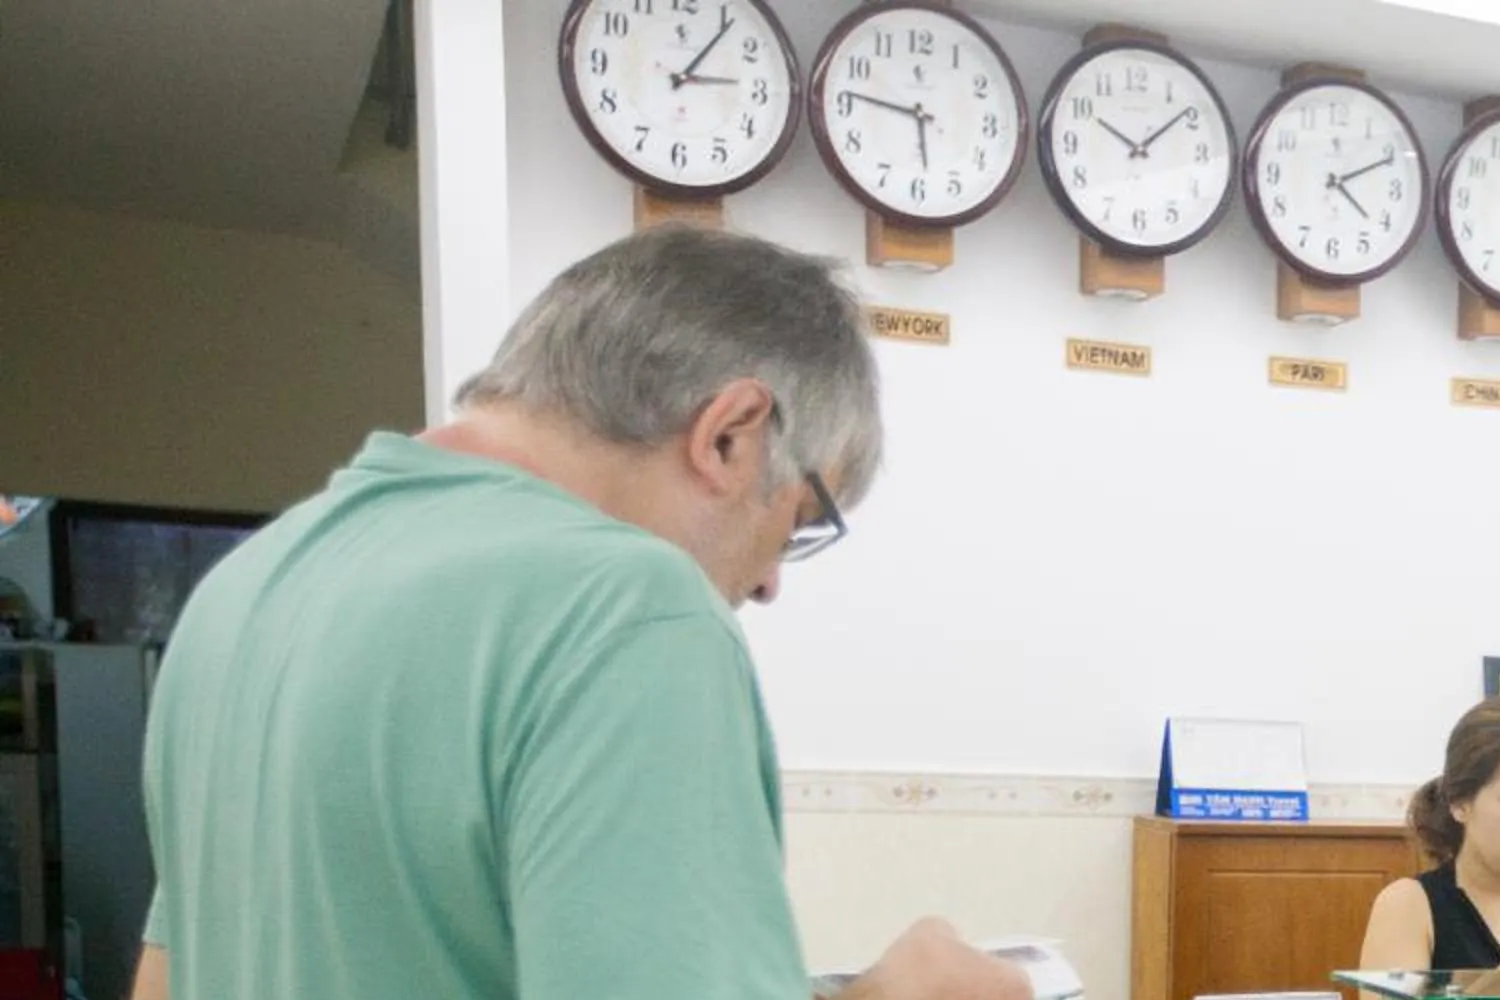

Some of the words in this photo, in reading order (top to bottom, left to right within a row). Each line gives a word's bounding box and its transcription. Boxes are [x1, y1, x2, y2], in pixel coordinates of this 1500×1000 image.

[603, 11, 628, 37] 10
[742, 37, 758, 64] 2
[874, 31, 892, 58] 11
[908, 29, 934, 56] 12
[590, 47, 608, 76] 9
[849, 56, 871, 80] 10
[952, 44, 959, 69] 1
[973, 75, 988, 99] 2
[1096, 73, 1112, 97] 11
[1125, 66, 1148, 92] 12
[599, 88, 617, 114] 8
[752, 78, 768, 106] 3
[836, 90, 854, 118] 9
[1165, 80, 1173, 104] 1
[1072, 96, 1093, 120] 10
[1186, 106, 1199, 131] 2
[1301, 106, 1316, 131] 11
[1330, 102, 1349, 127] 12
[633, 125, 650, 152] 7
[740, 112, 754, 140] 4
[983, 113, 997, 139] 3
[1365, 117, 1372, 140] 1
[712, 137, 728, 164] 5
[846, 129, 861, 154] 8
[1063, 130, 1078, 156] 9
[1277, 129, 1296, 151] 10
[671, 142, 687, 168] 6
[973, 145, 986, 171] 4
[1195, 143, 1210, 164] 3
[877, 163, 891, 188] 7
[947, 170, 962, 196] 5
[1073, 165, 1087, 189] 8
[1267, 162, 1280, 186] 9
[910, 178, 925, 201] 6
[1389, 178, 1402, 202] 3
[1103, 196, 1115, 221] 7
[1165, 200, 1179, 224] 5
[1273, 195, 1286, 218] 8
[1132, 208, 1146, 232] 6
[1379, 208, 1391, 232] 4
[1298, 224, 1311, 248] 7
[1325, 237, 1340, 260] 6
[1357, 231, 1370, 254] 5
[1482, 248, 1495, 271] 7
[873, 312, 944, 337] EWYORK
[1072, 343, 1146, 368] VIETNAM
[1290, 363, 1325, 382] PARI
